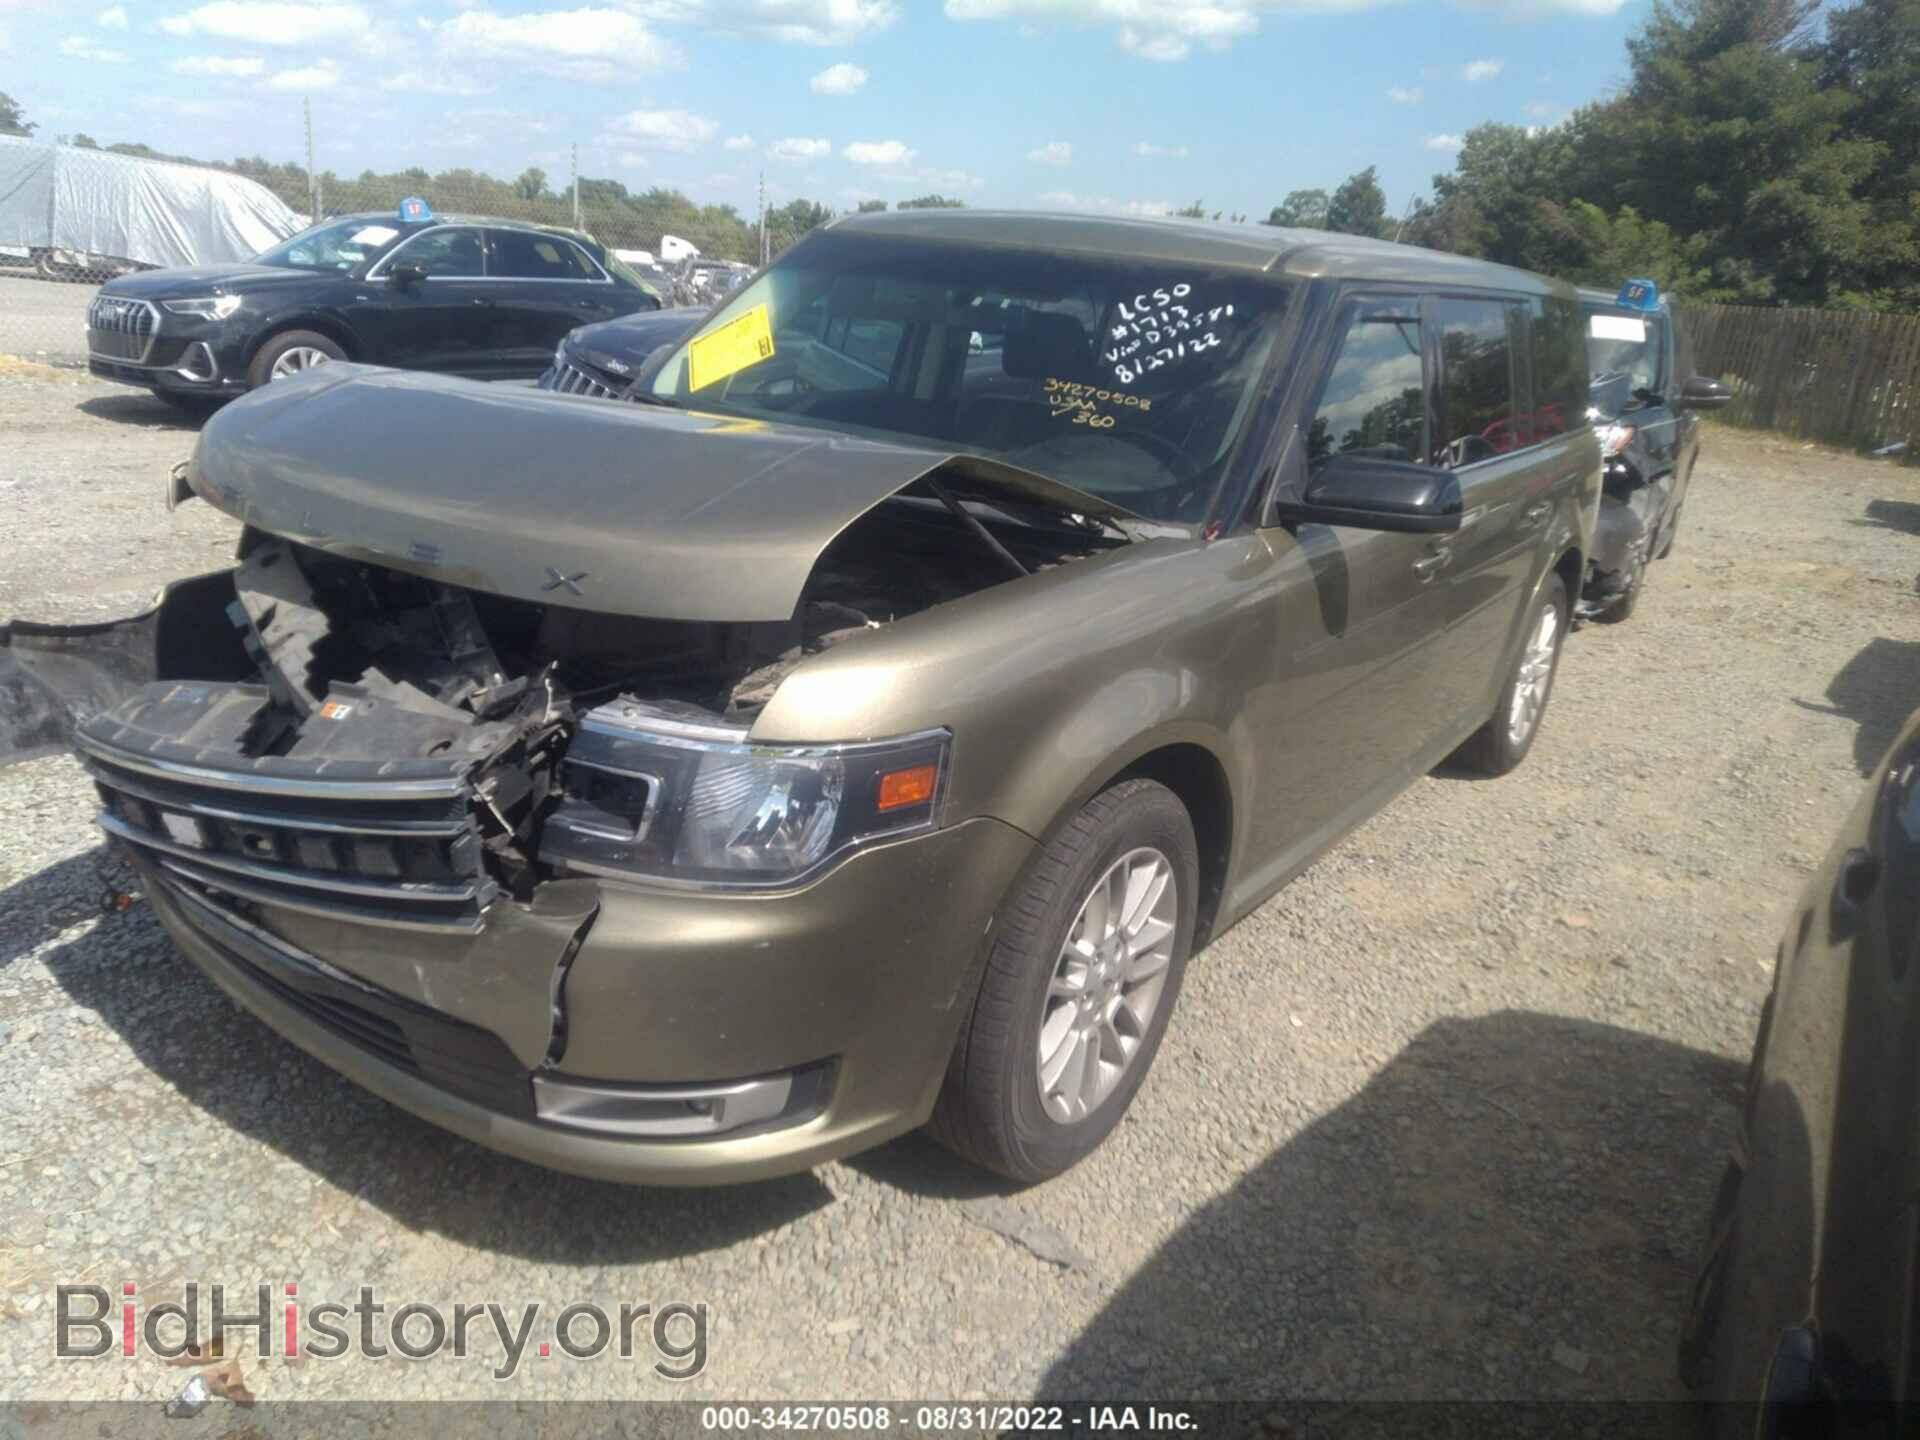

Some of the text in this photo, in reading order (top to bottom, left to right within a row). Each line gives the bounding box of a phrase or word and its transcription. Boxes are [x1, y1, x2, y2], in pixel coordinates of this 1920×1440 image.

[1112, 305, 1189, 340] #1713
[1043, 377, 1152, 411] 34270508
[1072, 410, 1115, 427] 360
